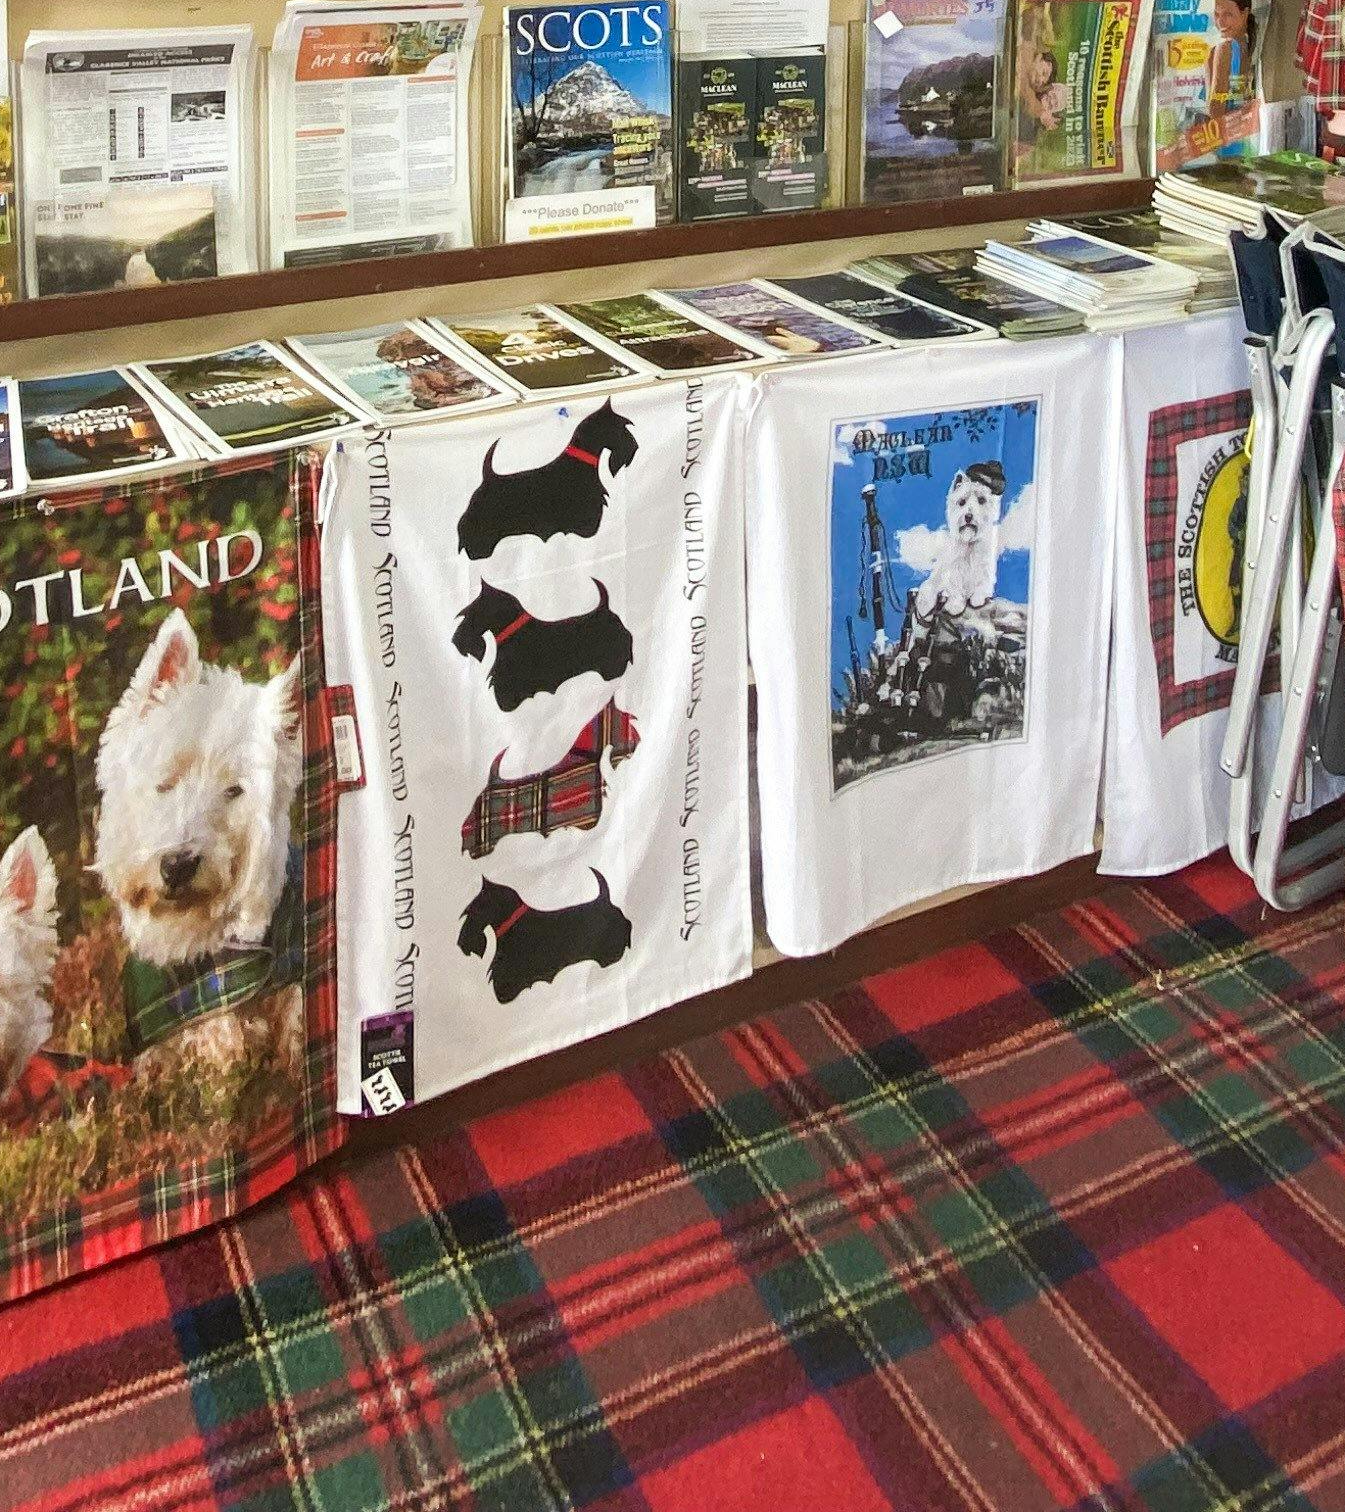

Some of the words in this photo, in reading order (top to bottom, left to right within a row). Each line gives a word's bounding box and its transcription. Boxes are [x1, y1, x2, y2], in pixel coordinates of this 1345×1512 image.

[311, 54, 335, 70] Art
[516, 5, 663, 56] SCOTS
[1079, 39, 1090, 54] 10
[1097, 20, 1121, 91] Scottish
[1114, 29, 1124, 50] the
[701, 84, 737, 94] MACLEAN
[773, 80, 807, 90] MACLEAN
[1066, 51, 1079, 114] Scotland
[1065, 118, 1075, 131] in
[1094, 94, 1109, 166] Banner
[496, 344, 595, 367] Drives
[682, 376, 704, 480] SCOTLAND
[365, 428, 392, 538] SCOTLAND
[1178, 450, 1227, 574] SCOTTISH
[683, 492, 705, 602] SCOTLAND
[370, 552, 397, 669] SCOTLAND
[1178, 579, 1197, 616] THE
[687, 615, 707, 719] SCOTLAND
[390, 681, 409, 802] SCOTLAND
[679, 727, 702, 829] SCOTLAND
[394, 813, 416, 931] SCOTLAND
[680, 836, 701, 943] SCOTLAND
